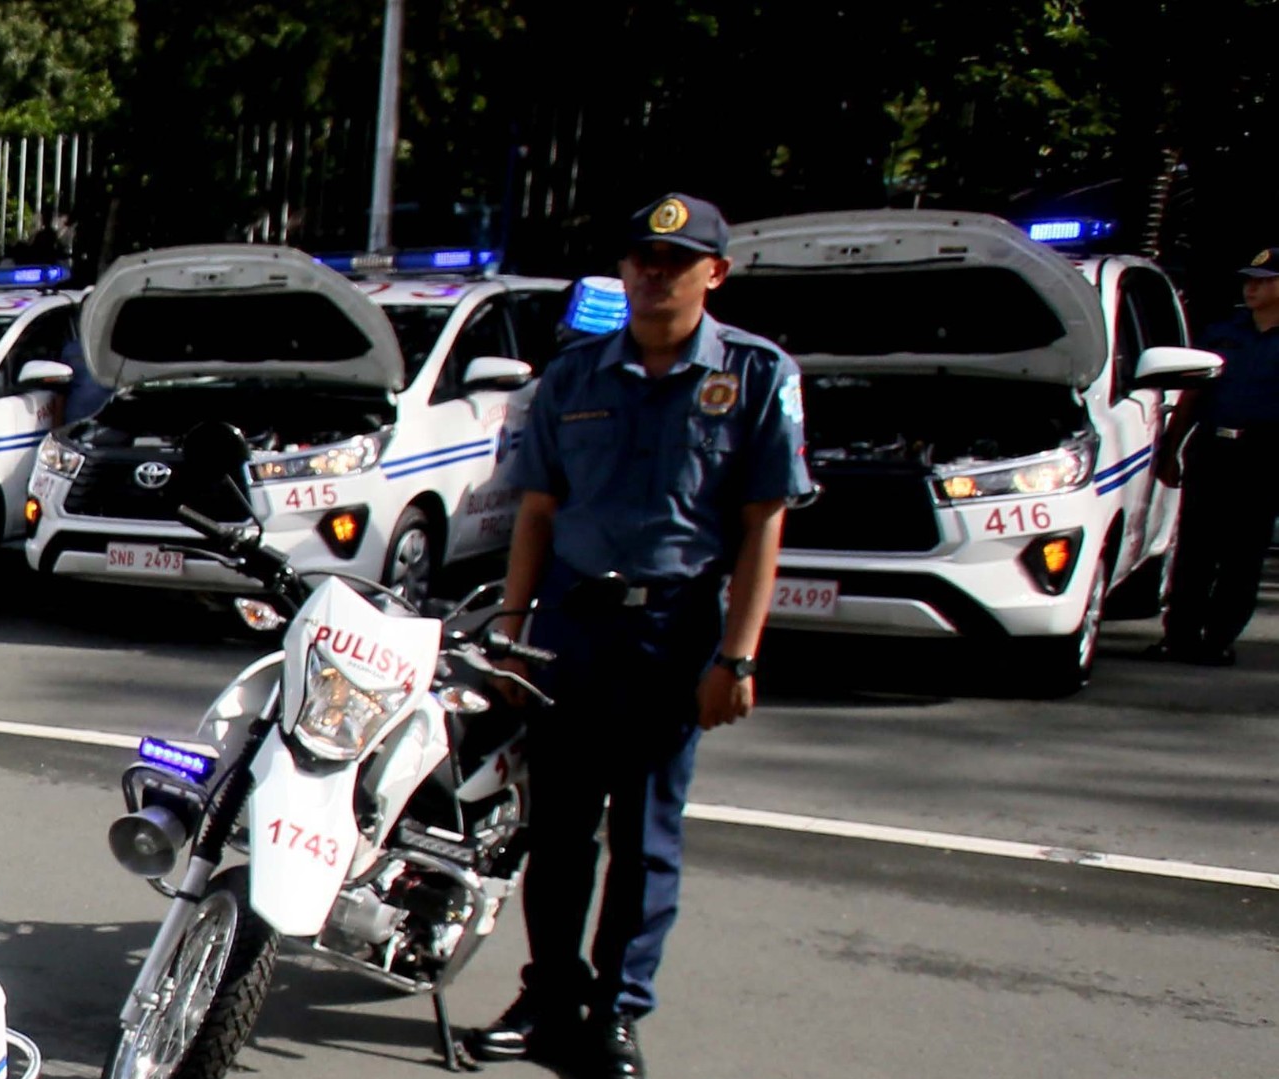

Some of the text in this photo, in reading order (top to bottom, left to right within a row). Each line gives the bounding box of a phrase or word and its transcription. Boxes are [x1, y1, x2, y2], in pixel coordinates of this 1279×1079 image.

[286, 483, 338, 508] 415
[985, 503, 1051, 534] 416
[109, 548, 184, 569] SNB 2493
[778, 586, 833, 608] 2499
[314, 626, 416, 694] PULISYA
[268, 819, 340, 867] 1743
